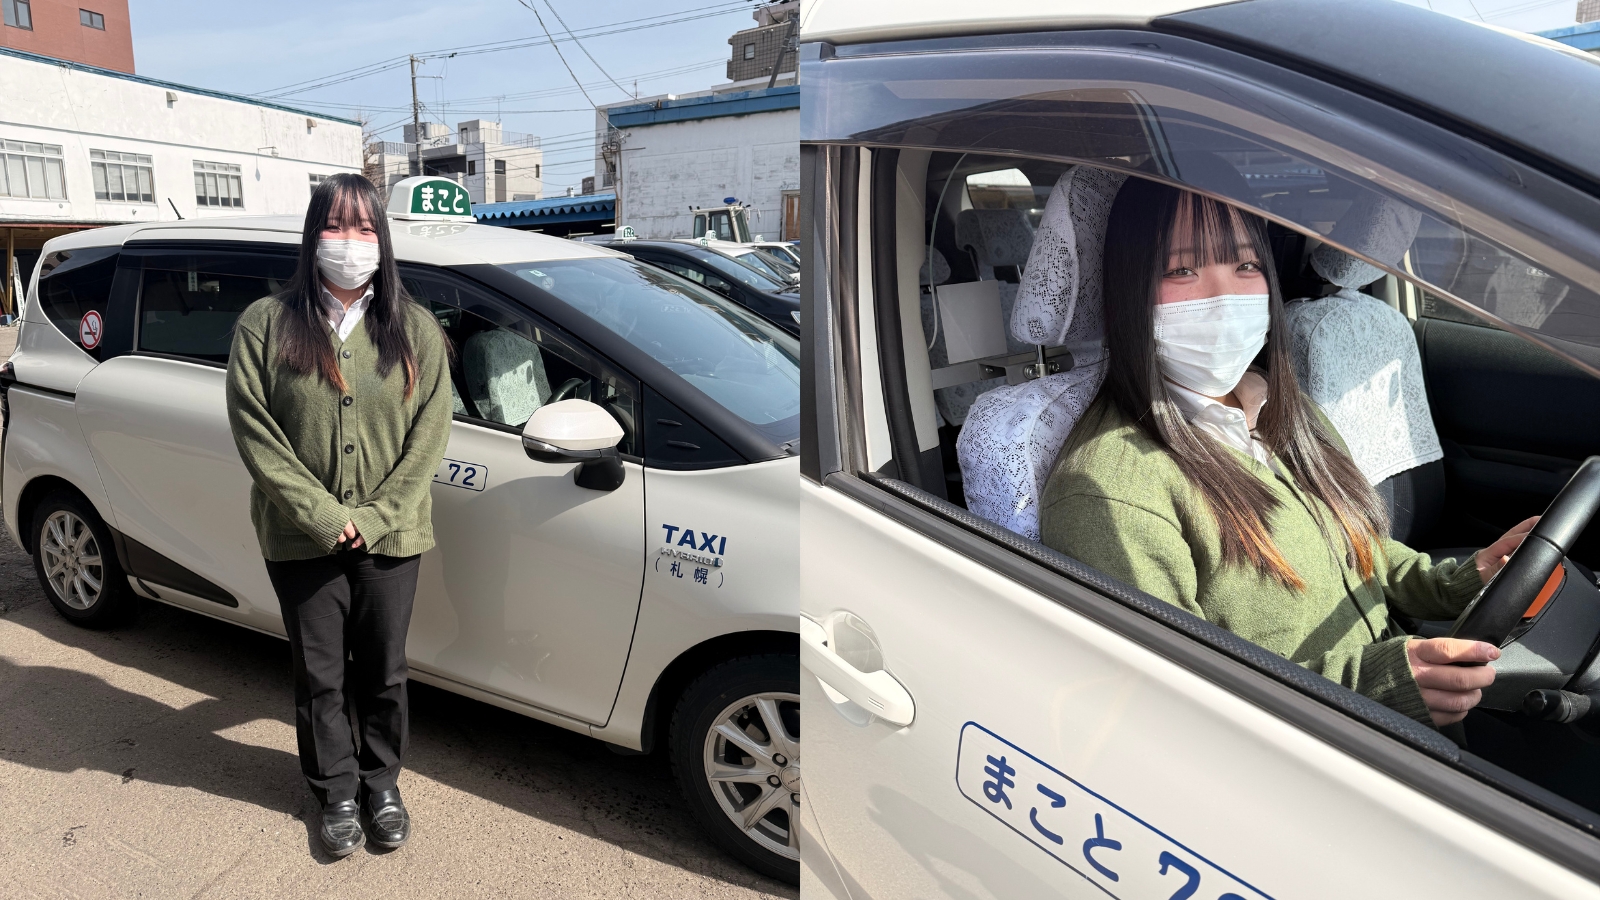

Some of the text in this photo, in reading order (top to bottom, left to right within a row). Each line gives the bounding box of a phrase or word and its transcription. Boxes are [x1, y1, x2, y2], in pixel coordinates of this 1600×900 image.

[421, 184, 464, 213] まこと
[448, 463, 477, 487] 72
[662, 523, 727, 555] TAXI
[660, 546, 714, 566] HYBRID
[982, 754, 1248, 900] まこと 7
